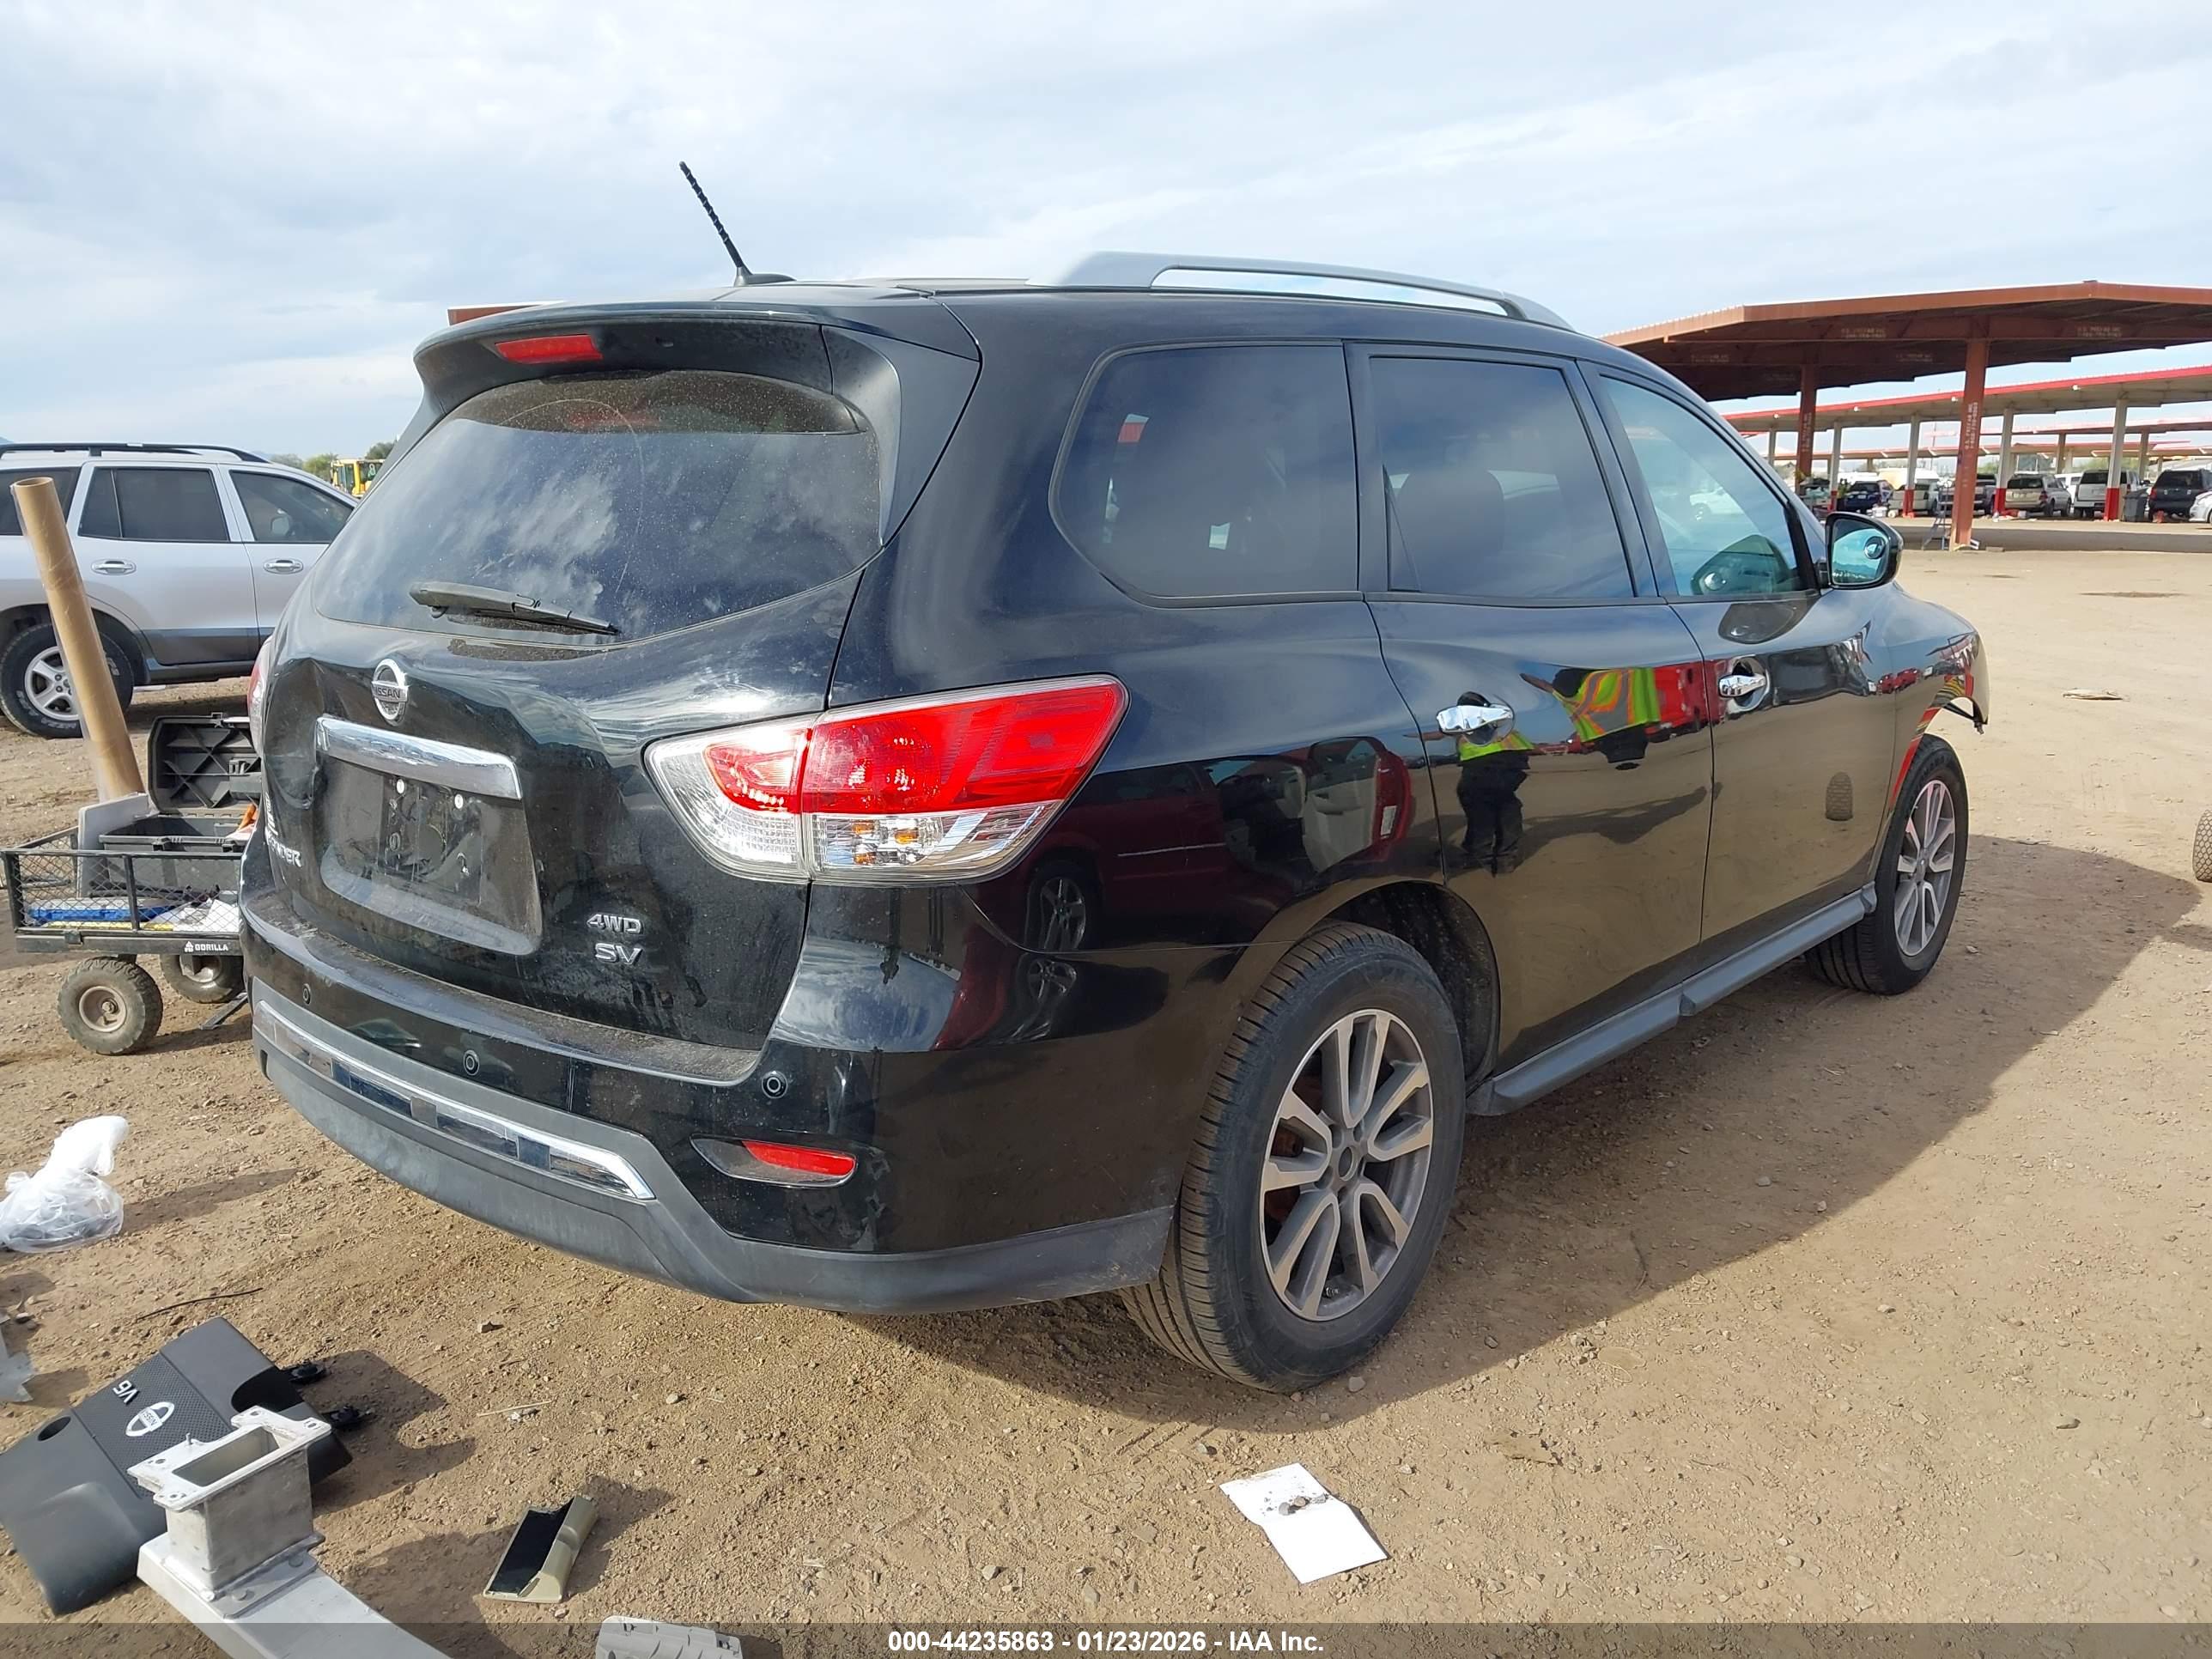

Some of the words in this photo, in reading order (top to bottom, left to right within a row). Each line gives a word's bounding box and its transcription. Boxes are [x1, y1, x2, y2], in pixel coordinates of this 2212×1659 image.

[372, 684, 400, 698] NISSAN
[586, 914, 642, 935] 4WD
[595, 943, 642, 964] SV
[112, 1380, 137, 1403] V6
